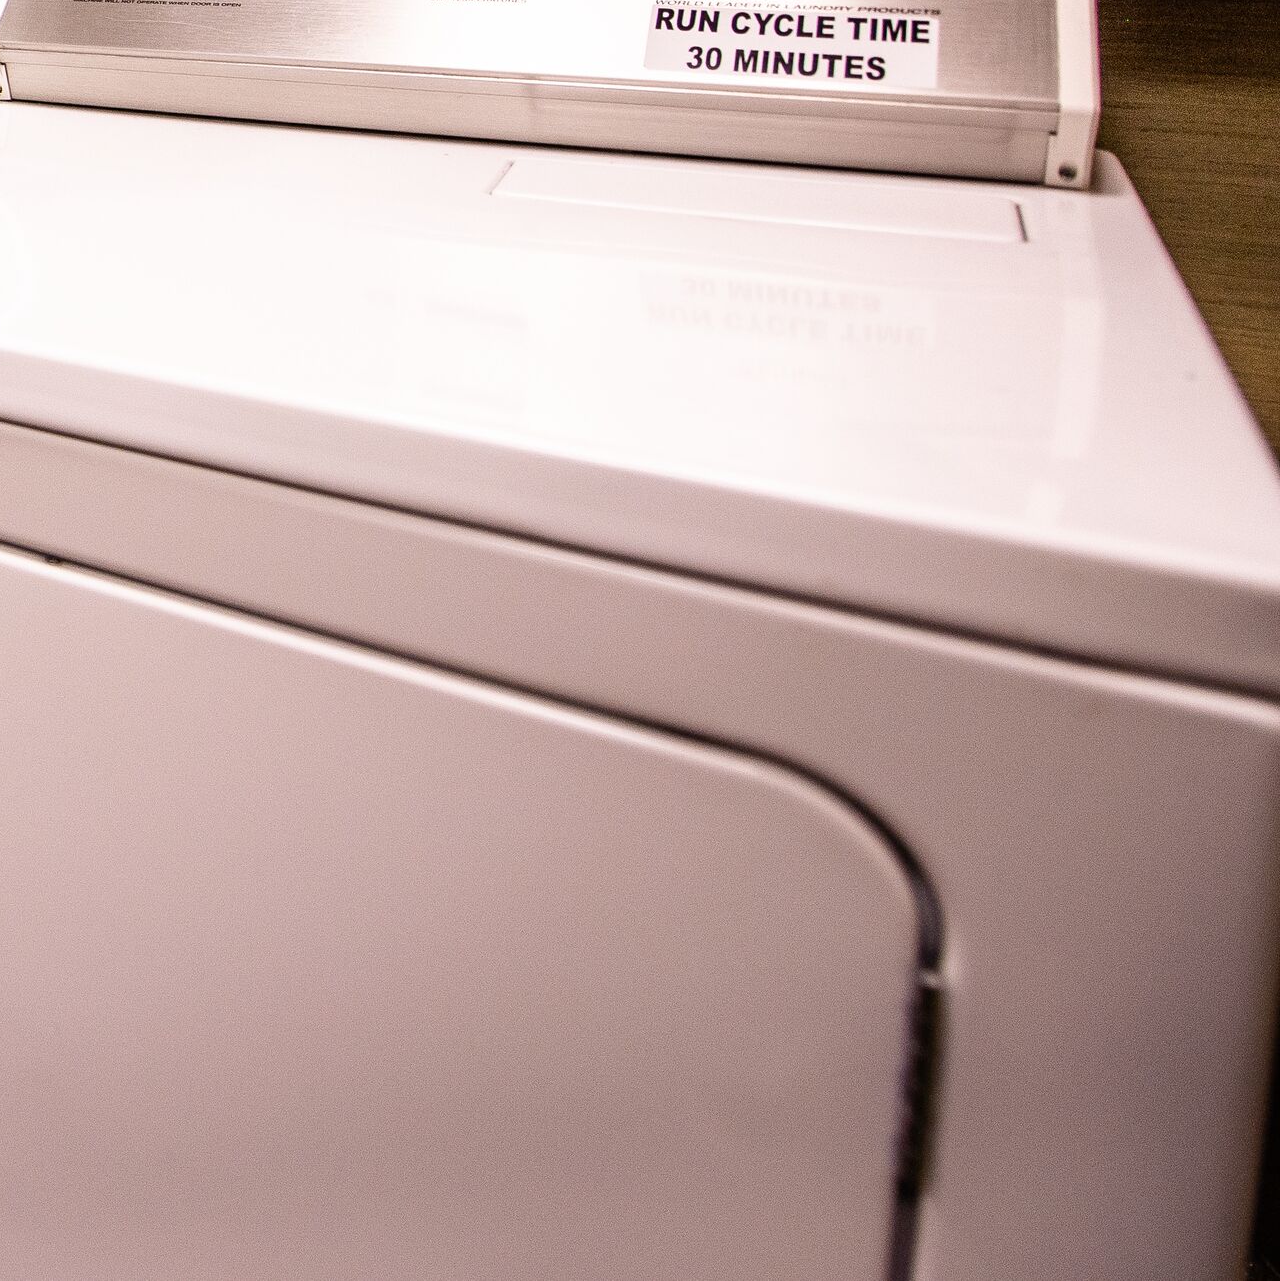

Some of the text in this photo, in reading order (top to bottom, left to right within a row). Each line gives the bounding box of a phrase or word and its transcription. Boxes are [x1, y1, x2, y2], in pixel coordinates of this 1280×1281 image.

[655, 0, 705, 7] WORLD
[708, 1, 764, 9] LEADER
[785, 4, 854, 12] LAUNDRY
[857, 6, 942, 16] PRODUCTS
[655, 8, 930, 44] RUN CYCLE TIME
[686, 46, 886, 81] 30 MINUTES
